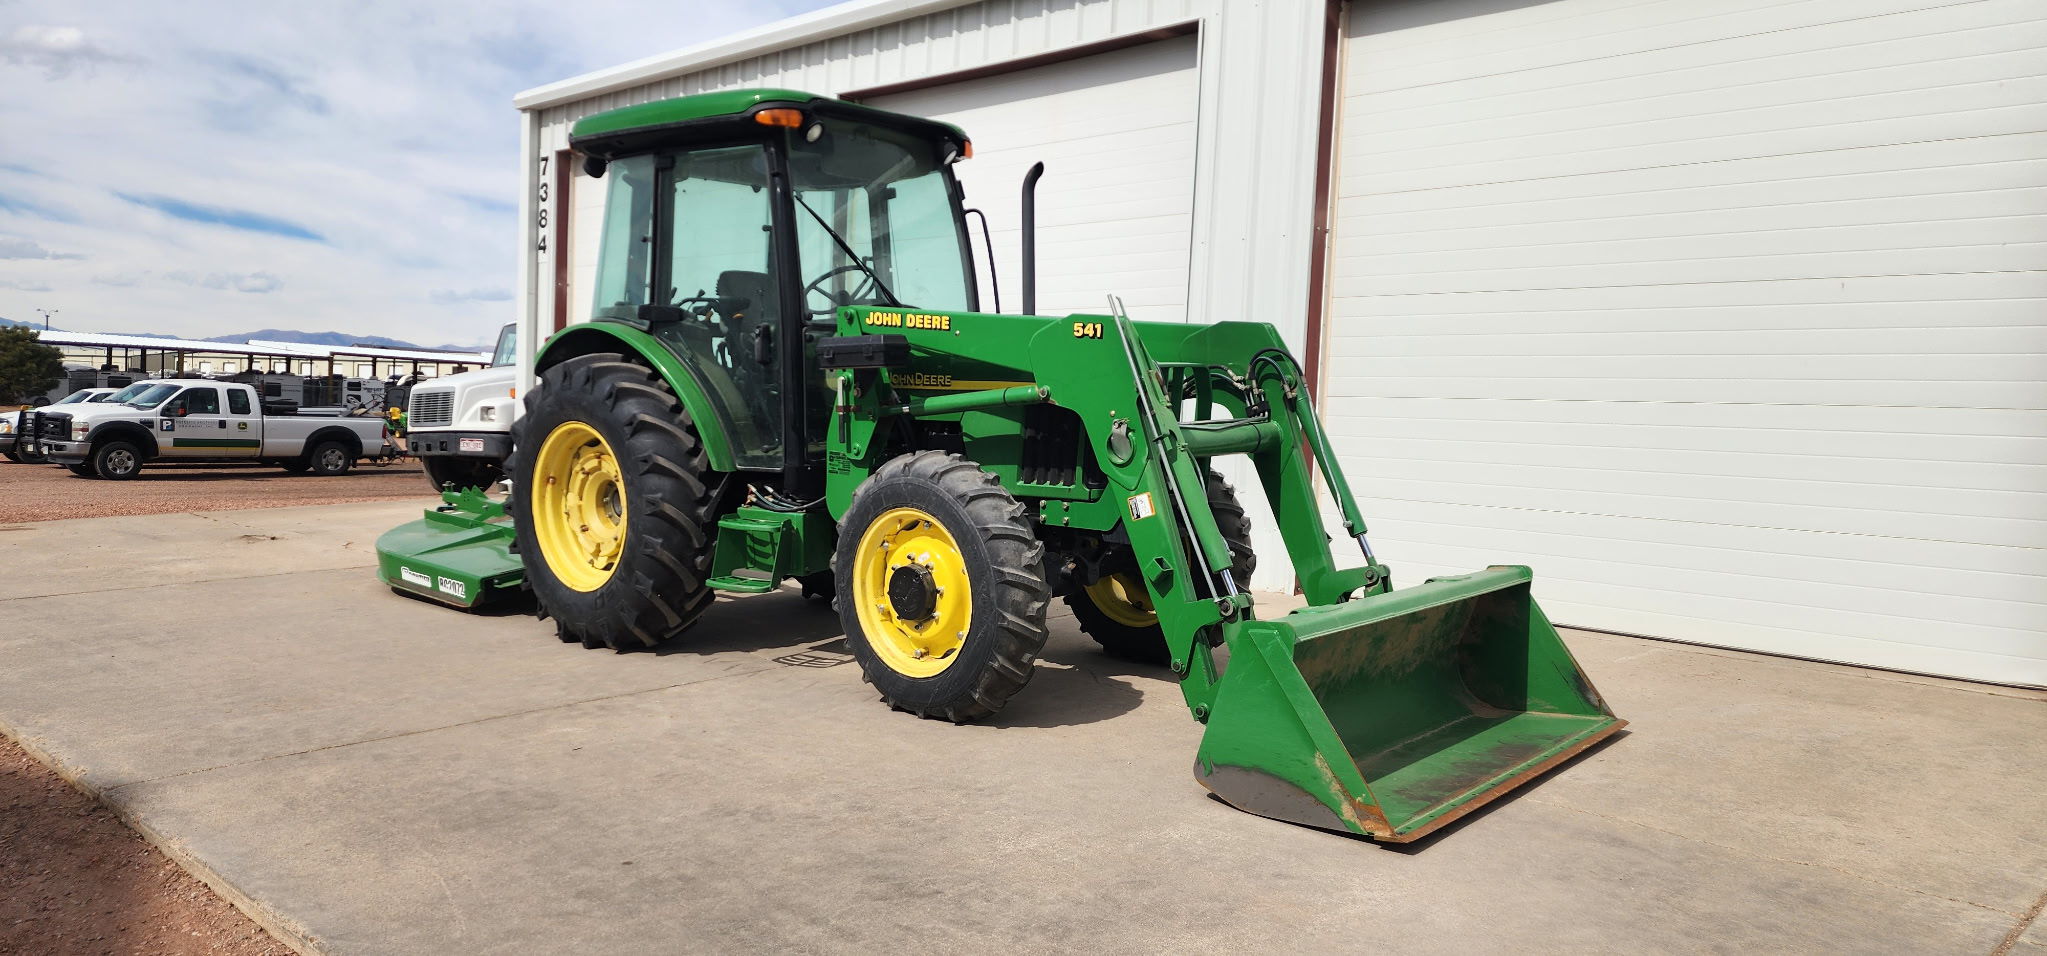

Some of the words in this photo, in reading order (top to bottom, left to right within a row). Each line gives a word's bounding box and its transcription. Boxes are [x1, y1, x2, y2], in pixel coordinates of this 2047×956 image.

[538, 156, 549, 253] 7384
[865, 311, 902, 328] JOHN
[906, 313, 951, 330] DEERE
[1073, 321, 1104, 340] 541
[915, 373, 952, 386] DEERE
